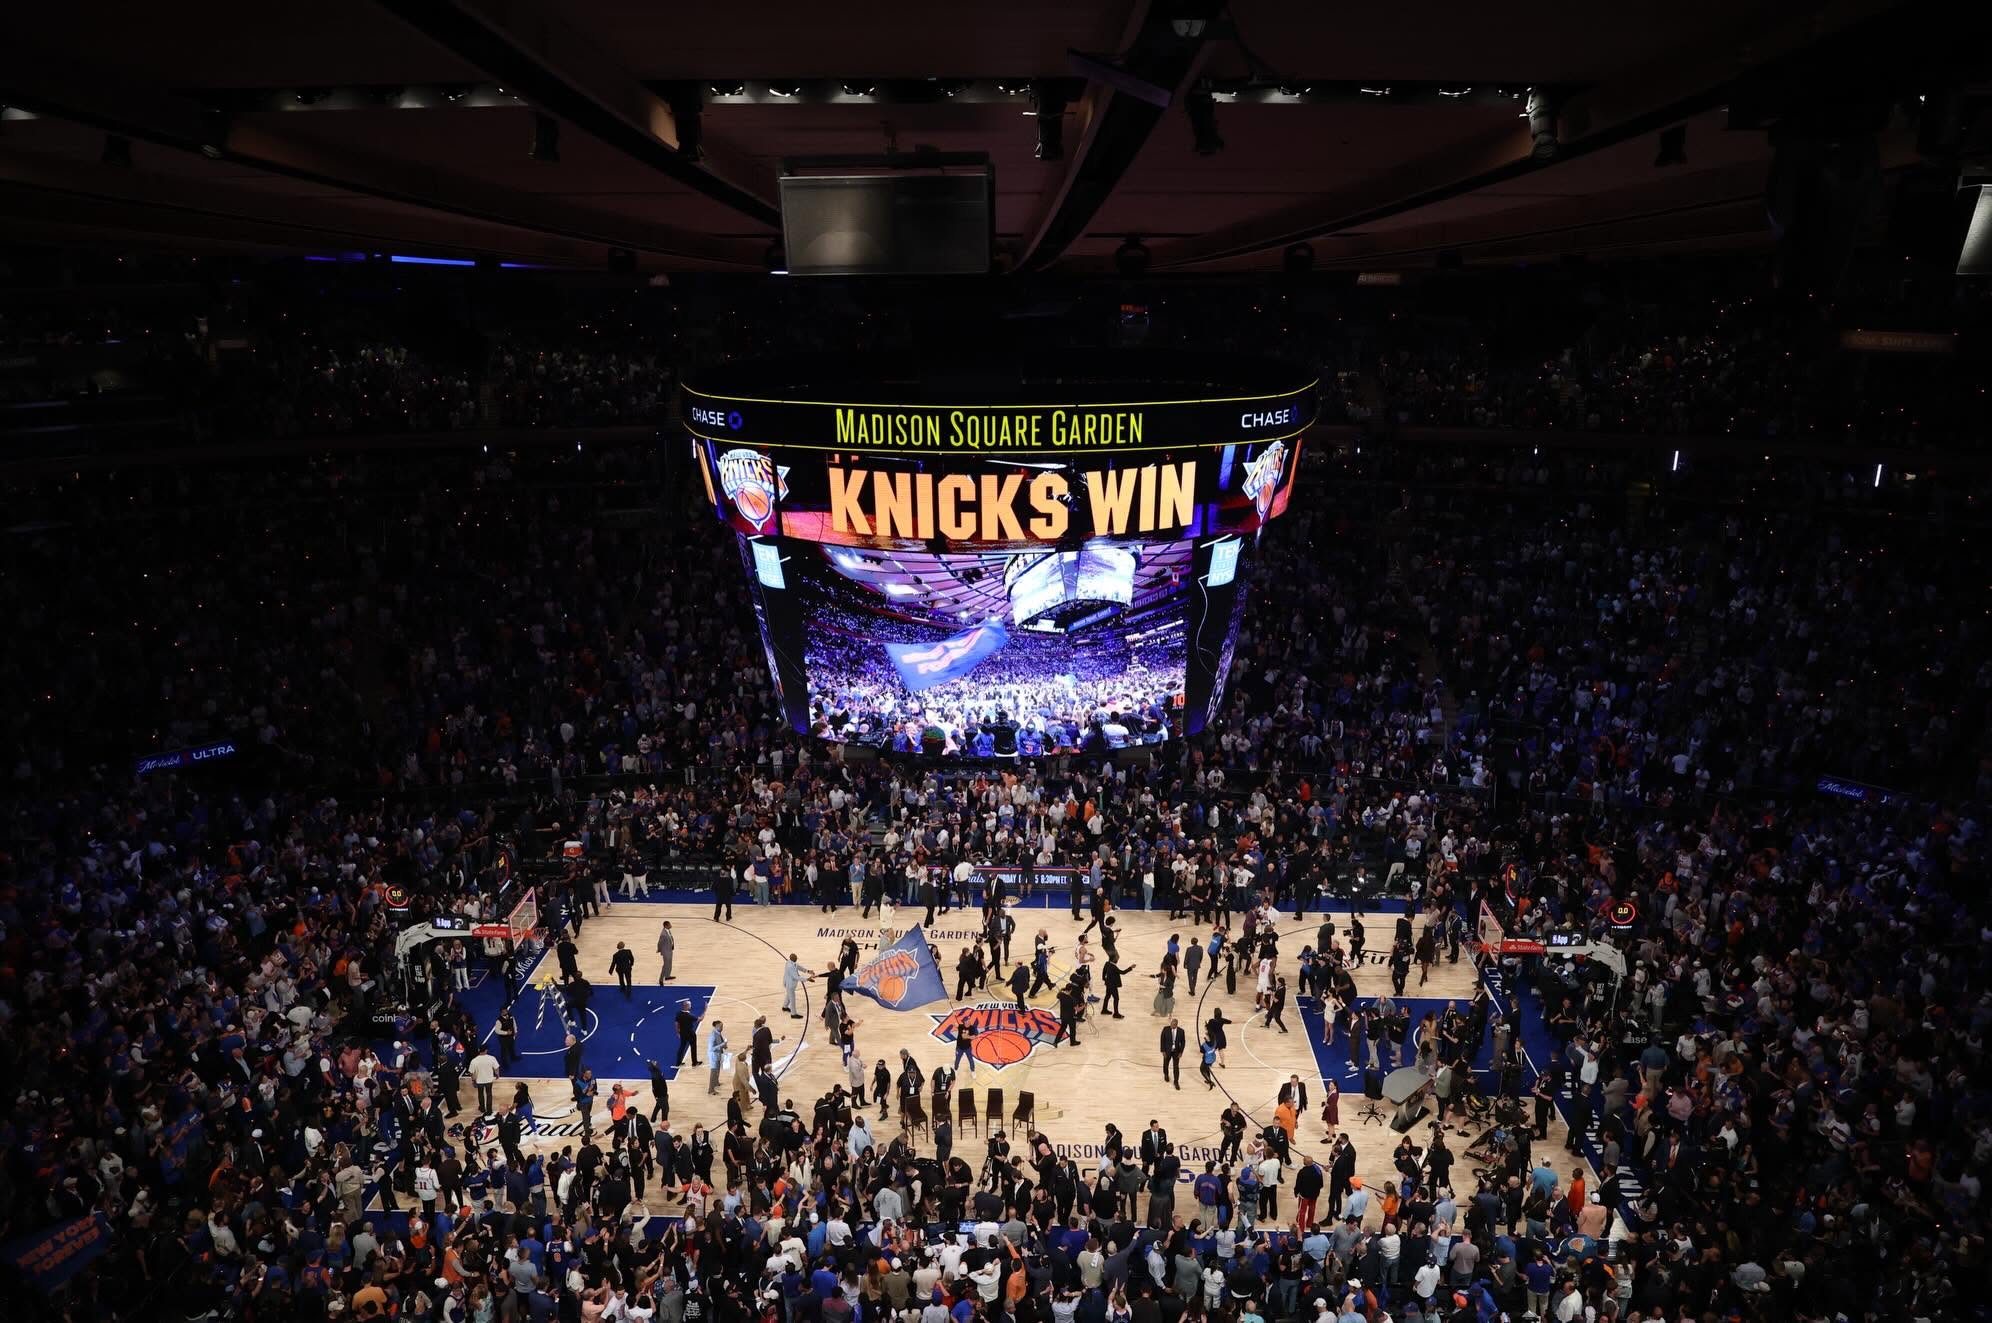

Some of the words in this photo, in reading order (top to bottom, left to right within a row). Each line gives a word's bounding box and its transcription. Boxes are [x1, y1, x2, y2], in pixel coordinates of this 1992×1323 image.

[692, 407, 725, 426] CHASE
[835, 408, 941, 446] MADISON
[950, 410, 1042, 450] SQUARE
[1052, 410, 1143, 446] GARDEN
[1241, 409, 1290, 428] CHASE
[829, 467, 1069, 541] KNICKS
[1086, 460, 1197, 537] WIN
[192, 744, 235, 760] ULTRA
[932, 1007, 1070, 1039] KNICKS
